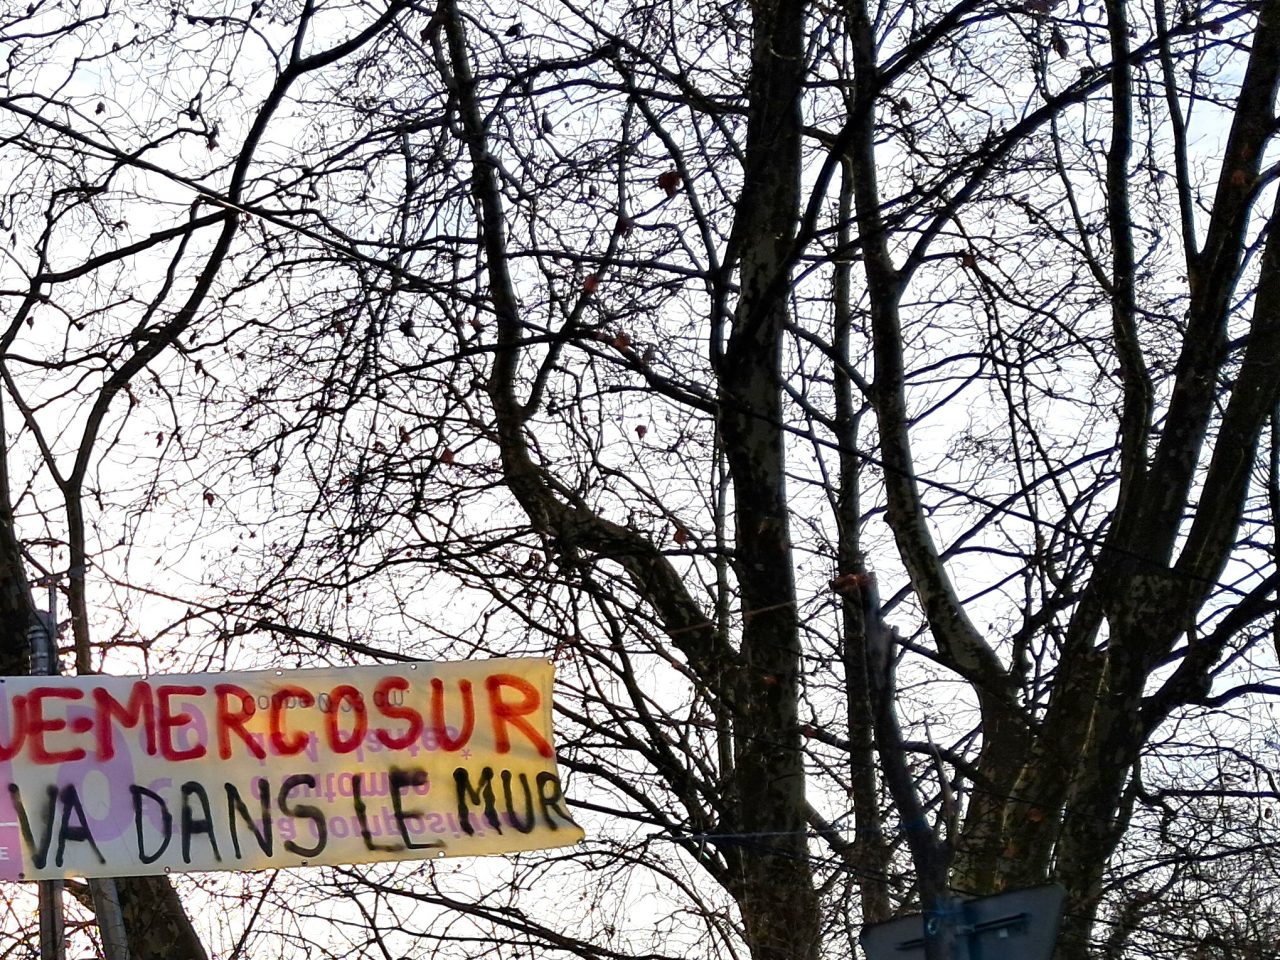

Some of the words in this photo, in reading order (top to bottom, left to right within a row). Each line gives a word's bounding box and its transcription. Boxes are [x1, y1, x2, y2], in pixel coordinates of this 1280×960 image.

[8, 781, 106, 871] VA
[129, 772, 328, 866] DANS
[354, 765, 447, 853] LE
[452, 765, 573, 837] MUR
